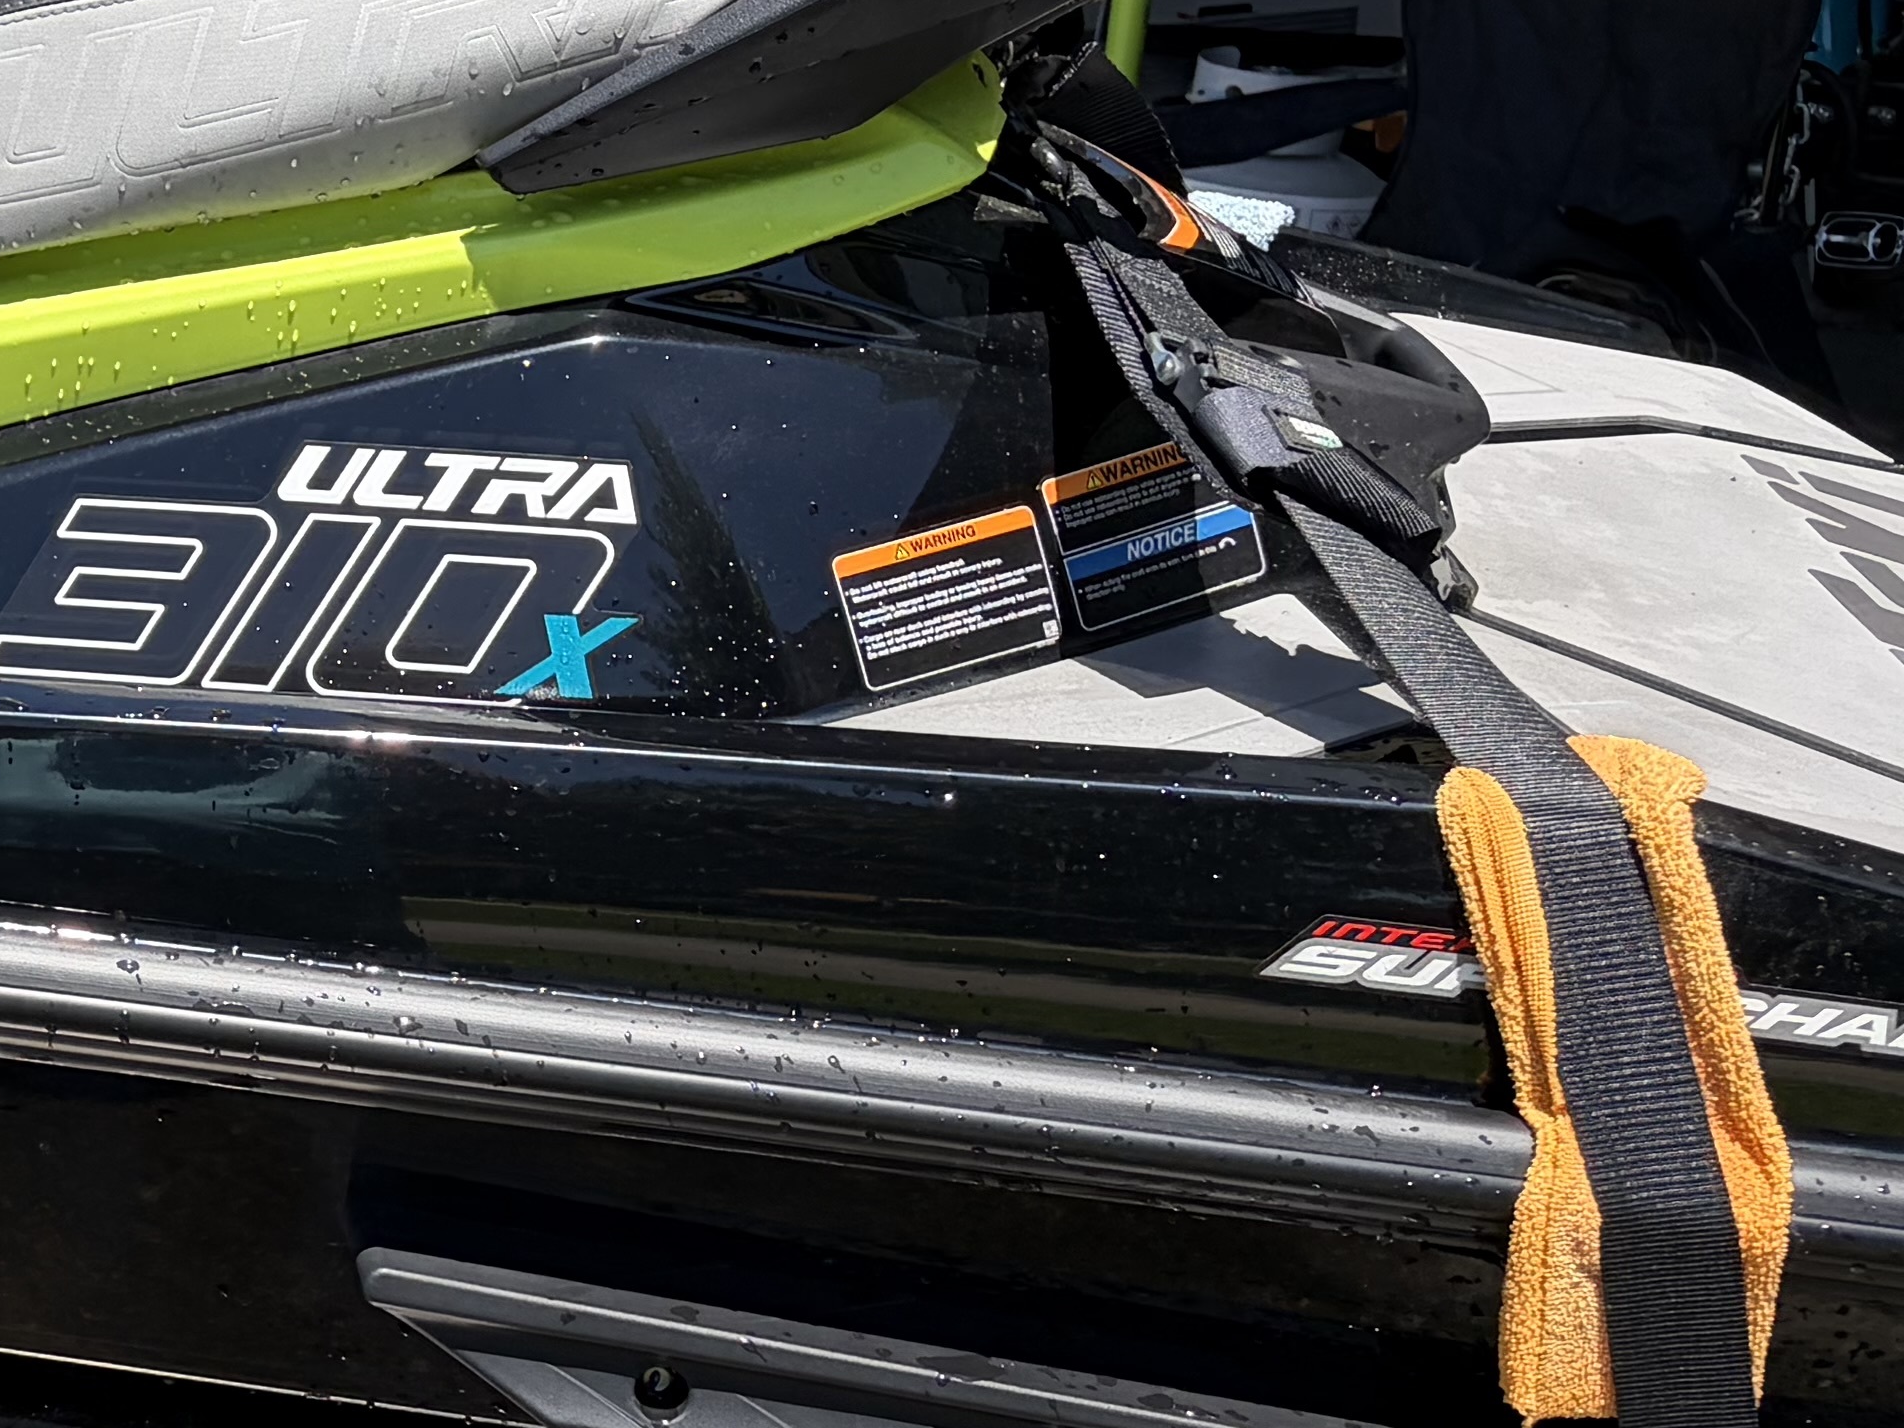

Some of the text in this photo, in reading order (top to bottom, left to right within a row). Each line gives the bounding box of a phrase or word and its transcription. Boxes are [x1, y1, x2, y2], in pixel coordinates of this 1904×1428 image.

[276, 442, 638, 525] ULTRA
[909, 524, 977, 553] WARNING
[1127, 523, 1196, 561] NOTICE
